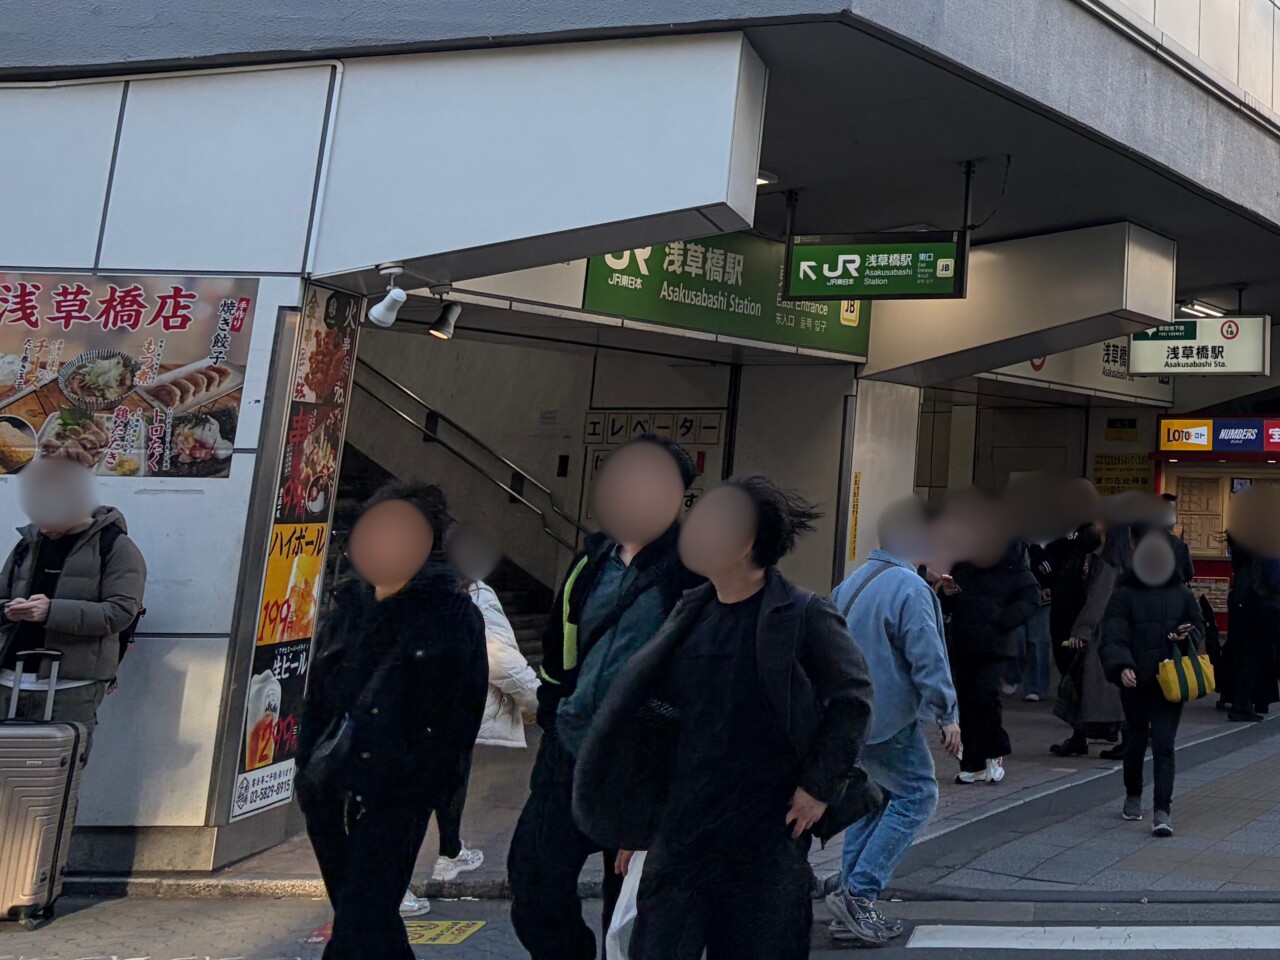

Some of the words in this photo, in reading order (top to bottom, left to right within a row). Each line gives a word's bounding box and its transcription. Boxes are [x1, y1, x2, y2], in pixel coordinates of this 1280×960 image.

[663, 240, 744, 286] 浅草橋駅
[823, 254, 861, 277] JR
[865, 253, 912, 267] 浅草橋駅
[918, 253, 934, 262] 東口
[864, 268, 913, 276] Asakusabashi
[940, 263, 950, 272] JB
[607, 272, 643, 290] JR東日本
[826, 278, 855, 286] JR東日本
[863, 277, 888, 285] Station
[0, 283, 197, 331] 浅草橋店
[659, 280, 728, 311] Asakusabashi
[729, 292, 762, 317] Station
[795, 299, 828, 316] Entrance
[845, 300, 855, 314] JB
[233, 300, 248, 328] 手作り
[775, 312, 795, 327] 东入口
[209, 299, 237, 366] 焼き餃子
[133, 337, 157, 386] もつ煮
[1166, 345, 1225, 360] 浅草橋駅
[24, 338, 49, 391] チーズ
[1164, 360, 1212, 368] Asakusabashi
[1213, 360, 1227, 368] Sta.
[587, 417, 718, 437] エレベーター
[1167, 427, 1190, 443] LOTO
[1218, 428, 1258, 440] NUMBERS
[104, 406, 130, 467] 鶏たたき
[148, 409, 166, 472] トロたく
[268, 526, 328, 560] ハイボール
[272, 651, 308, 680] 生ビール
